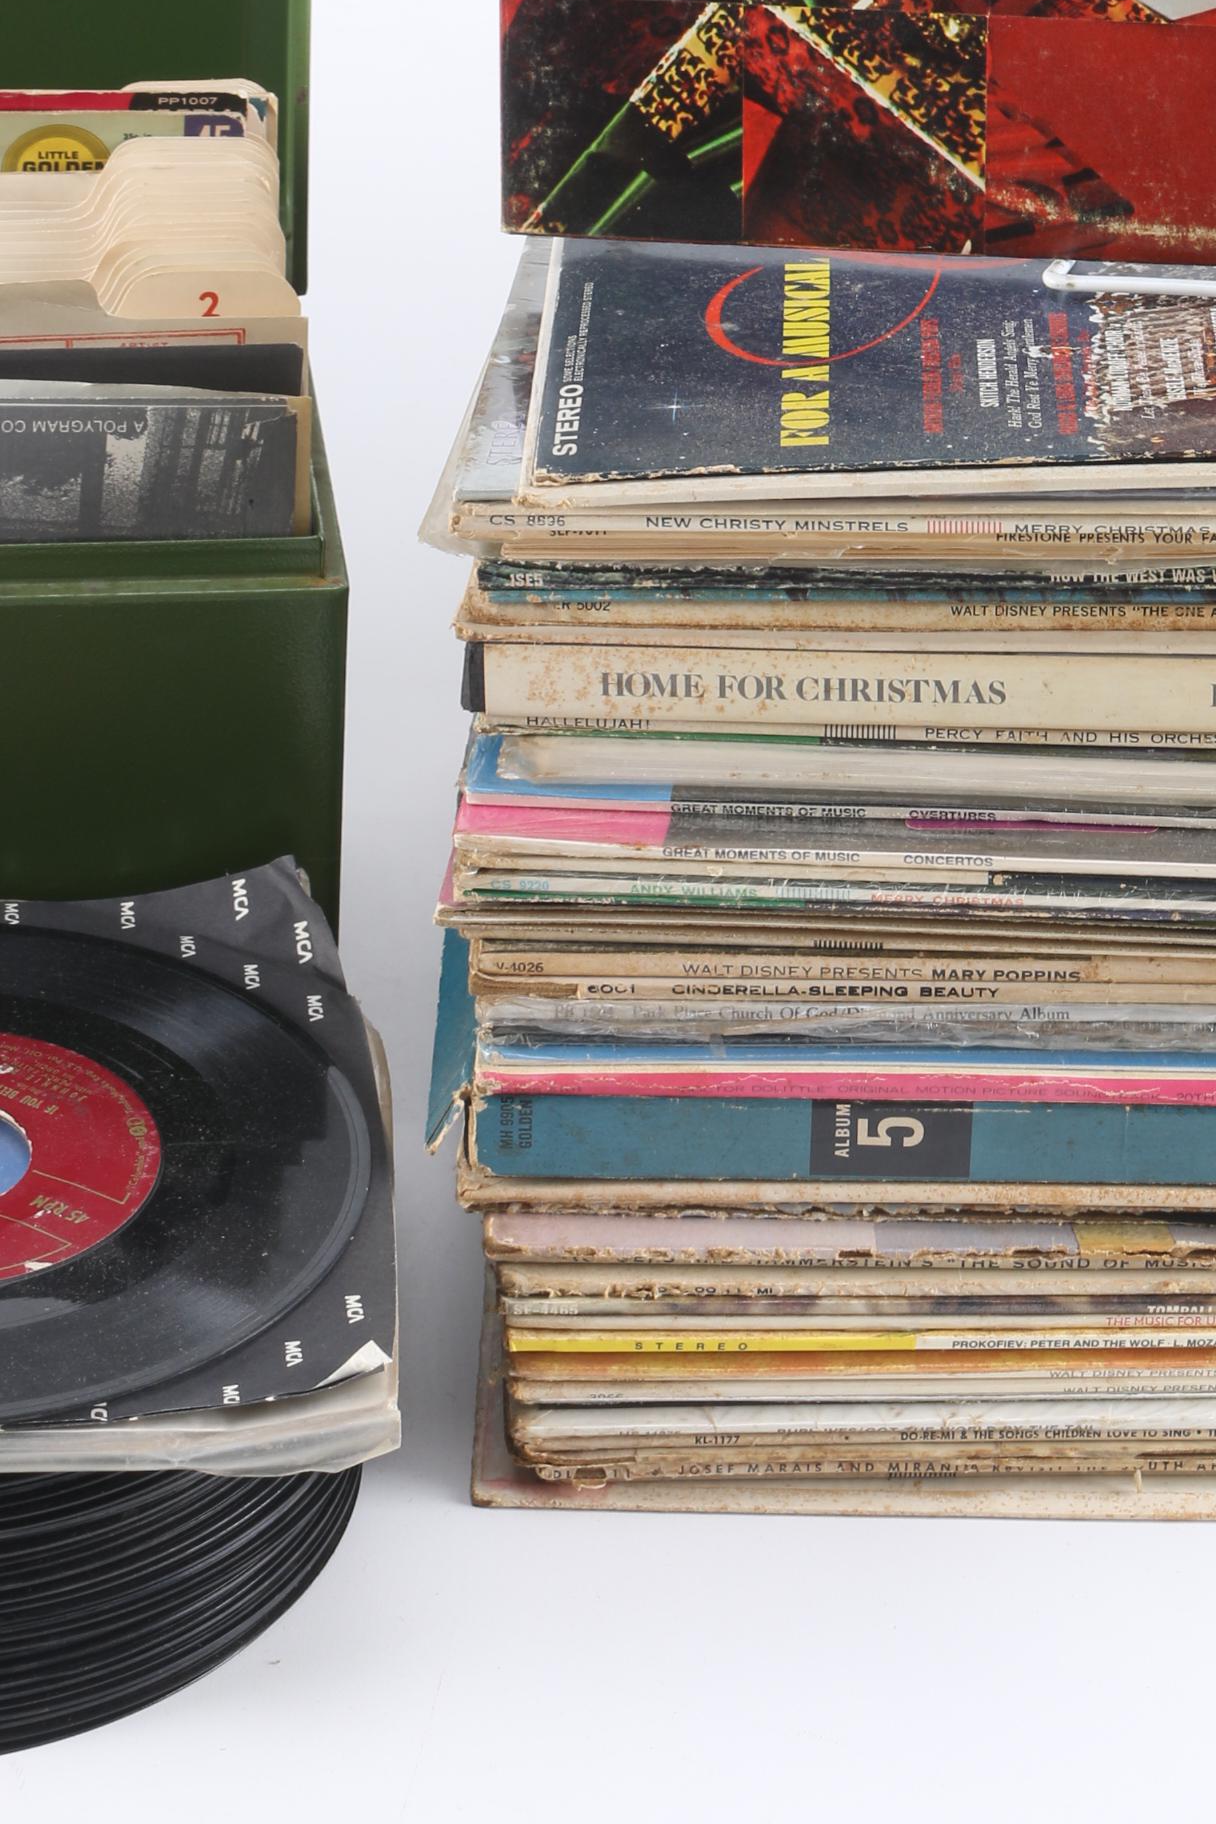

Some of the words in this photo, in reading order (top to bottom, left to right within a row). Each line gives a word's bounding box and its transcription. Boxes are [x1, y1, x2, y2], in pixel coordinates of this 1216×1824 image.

[158, 97, 218, 106] PP1007
[38, 151, 78, 160] LITTLE
[199, 292, 220, 317] 2
[976, 338, 997, 380] HENDERSON
[781, 365, 830, 381] A
[1004, 364, 1019, 388] Herald
[980, 381, 999, 408] SKITCH
[1005, 389, 1020, 404] The
[1027, 394, 1041, 410] Rest
[33, 420, 128, 433] POLYGRAM
[133, 421, 145, 433] A
[553, 385, 584, 456] STEREO
[780, 390, 830, 447] FOR
[1028, 412, 1043, 429] God
[490, 515, 515, 526] CS
[646, 517, 691, 528] NEW
[700, 518, 786, 530] CHRISTY
[795, 520, 908, 532] MINSTRELS
[1015, 524, 1087, 534] MERRY
[1096, 525, 1210, 535] CHRISTMAS
[1079, 533, 1145, 544] PRESENTS
[1153, 533, 1192, 545] YOUR
[1126, 570, 1165, 583] WEST
[1172, 570, 1206, 583] WAS
[951, 606, 990, 617] WALT
[995, 606, 1047, 617] DISNEY
[1053, 606, 1126, 617] PRESENTS
[1175, 607, 1205, 617] ONE
[600, 671, 705, 698] HOME
[717, 674, 786, 701] FOR
[796, 676, 1007, 705] CHRISTMAS
[526, 716, 650, 730] HALLELUJAH!
[925, 728, 983, 740] PERCY
[996, 730, 1048, 742] FAITH
[1062, 732, 1097, 743] AND
[1109, 733, 1140, 744] HIS
[670, 803, 718, 814] GREAT
[722, 805, 792, 816] MOMENTS
[821, 808, 866, 819] MUSIC
[909, 810, 997, 821] OVERTURES
[662, 847, 708, 858] GREAT
[715, 848, 787, 861] MOMENTS
[791, 851, 810, 861] OF
[815, 851, 861, 863] MUSIC
[904, 854, 994, 867] CONCERTOS
[232, 878, 249, 921] MCA
[630, 884, 674, 895] ANDY
[682, 886, 758, 898] WILLIAMS
[4, 903, 20, 925] MCA
[120, 901, 136, 929] MCA
[179, 935, 196, 958] MCA
[293, 920, 313, 964] MCA
[243, 964, 260, 990] MCA
[682, 964, 733, 976] WALT
[741, 965, 813, 977] DISNEY
[820, 966, 923, 979] PRESENTS
[931, 969, 986, 981] MARY
[993, 970, 1081, 982] POPPINS
[920, 986, 999, 998] BEAUTY
[306, 994, 324, 1022] MCA
[1020, 1007, 1070, 1021] Album
[519, 1099, 533, 1150] GOLDEN
[834, 1103, 851, 1158] ALBUM
[857, 1115, 925, 1148] 5
[30, 1194, 69, 1216] RPM
[69, 1210, 90, 1224] 45
[344, 1294, 364, 1324] MCA
[1106, 1317, 1131, 1327] THE
[1135, 1316, 1176, 1327] MUSIC
[1178, 1316, 1203, 1326] FOR
[284, 1340, 303, 1367] MCA
[952, 1340, 1028, 1349] PROKOFIEV:
[1030, 1340, 1069, 1348] PETER
[1072, 1339, 1099, 1348] AND
[1104, 1339, 1127, 1348] THE
[1130, 1339, 1165, 1347] WOLF
[695, 1435, 740, 1445] KL-1177
[901, 1431, 956, 1441] DO-RE-MI
[973, 1430, 994, 1440] THE
[1045, 1430, 1101, 1439] CHILDREN
[677, 1463, 735, 1475] JOSEF
[747, 1462, 823, 1473] MARAIS
